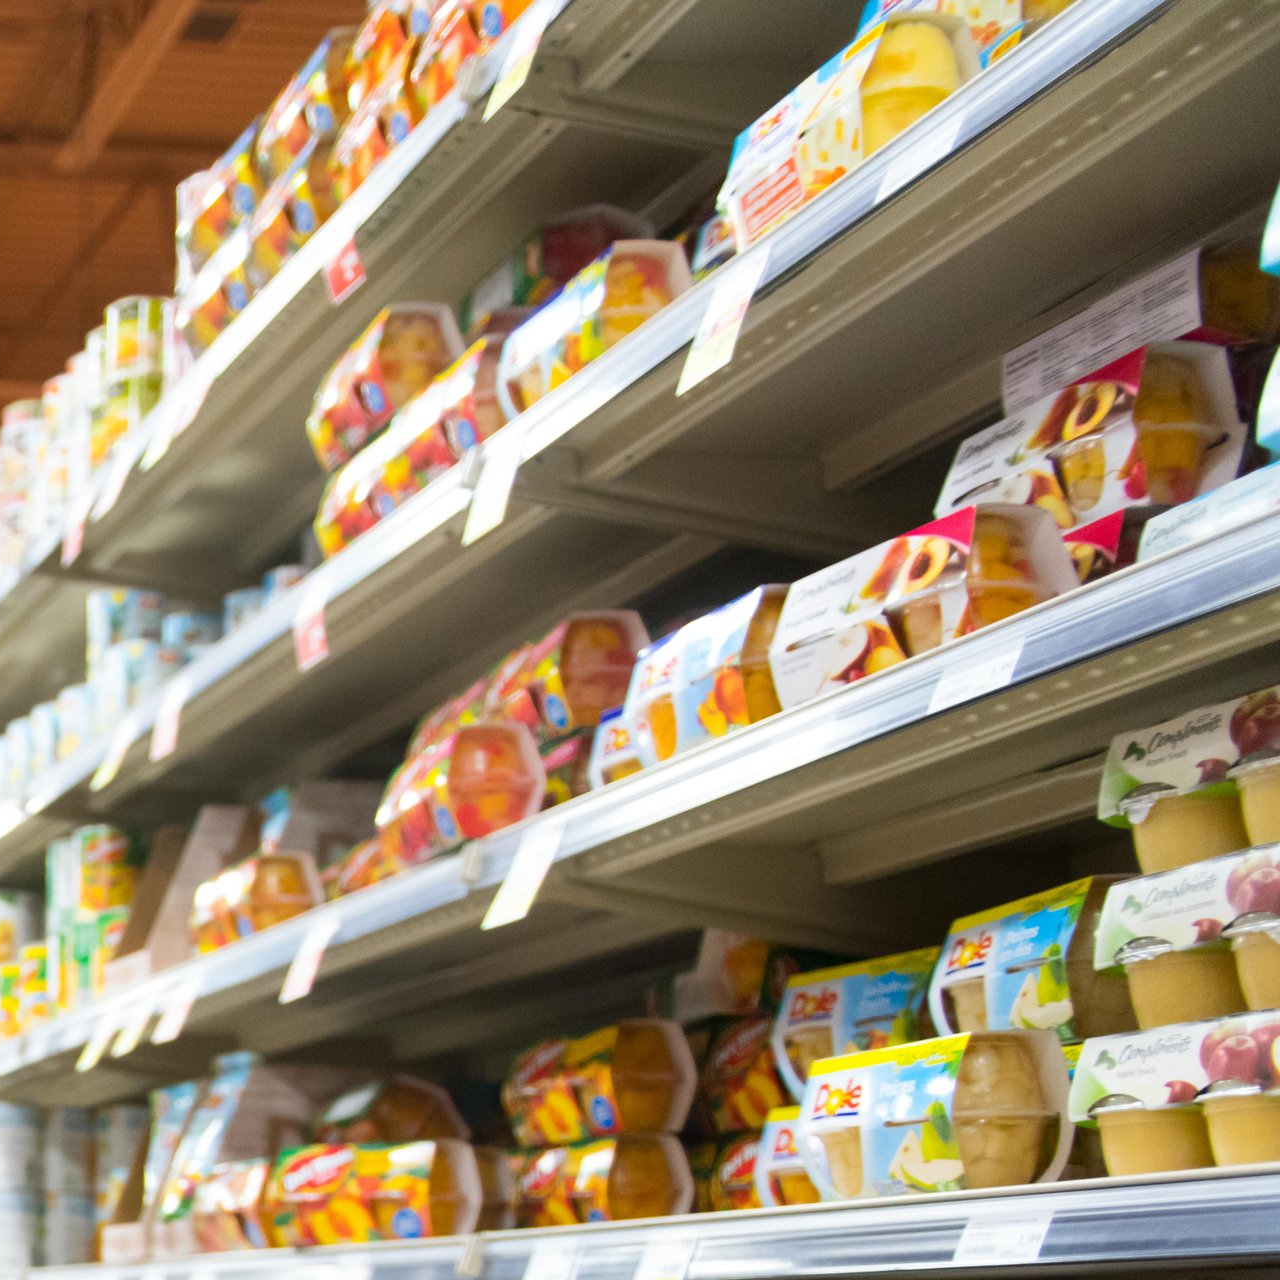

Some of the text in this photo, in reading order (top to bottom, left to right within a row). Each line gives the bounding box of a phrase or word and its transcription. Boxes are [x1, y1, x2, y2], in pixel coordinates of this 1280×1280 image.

[947, 930, 993, 970] Dole
[791, 987, 838, 1022] Dole
[814, 1079, 862, 1115] Dole
